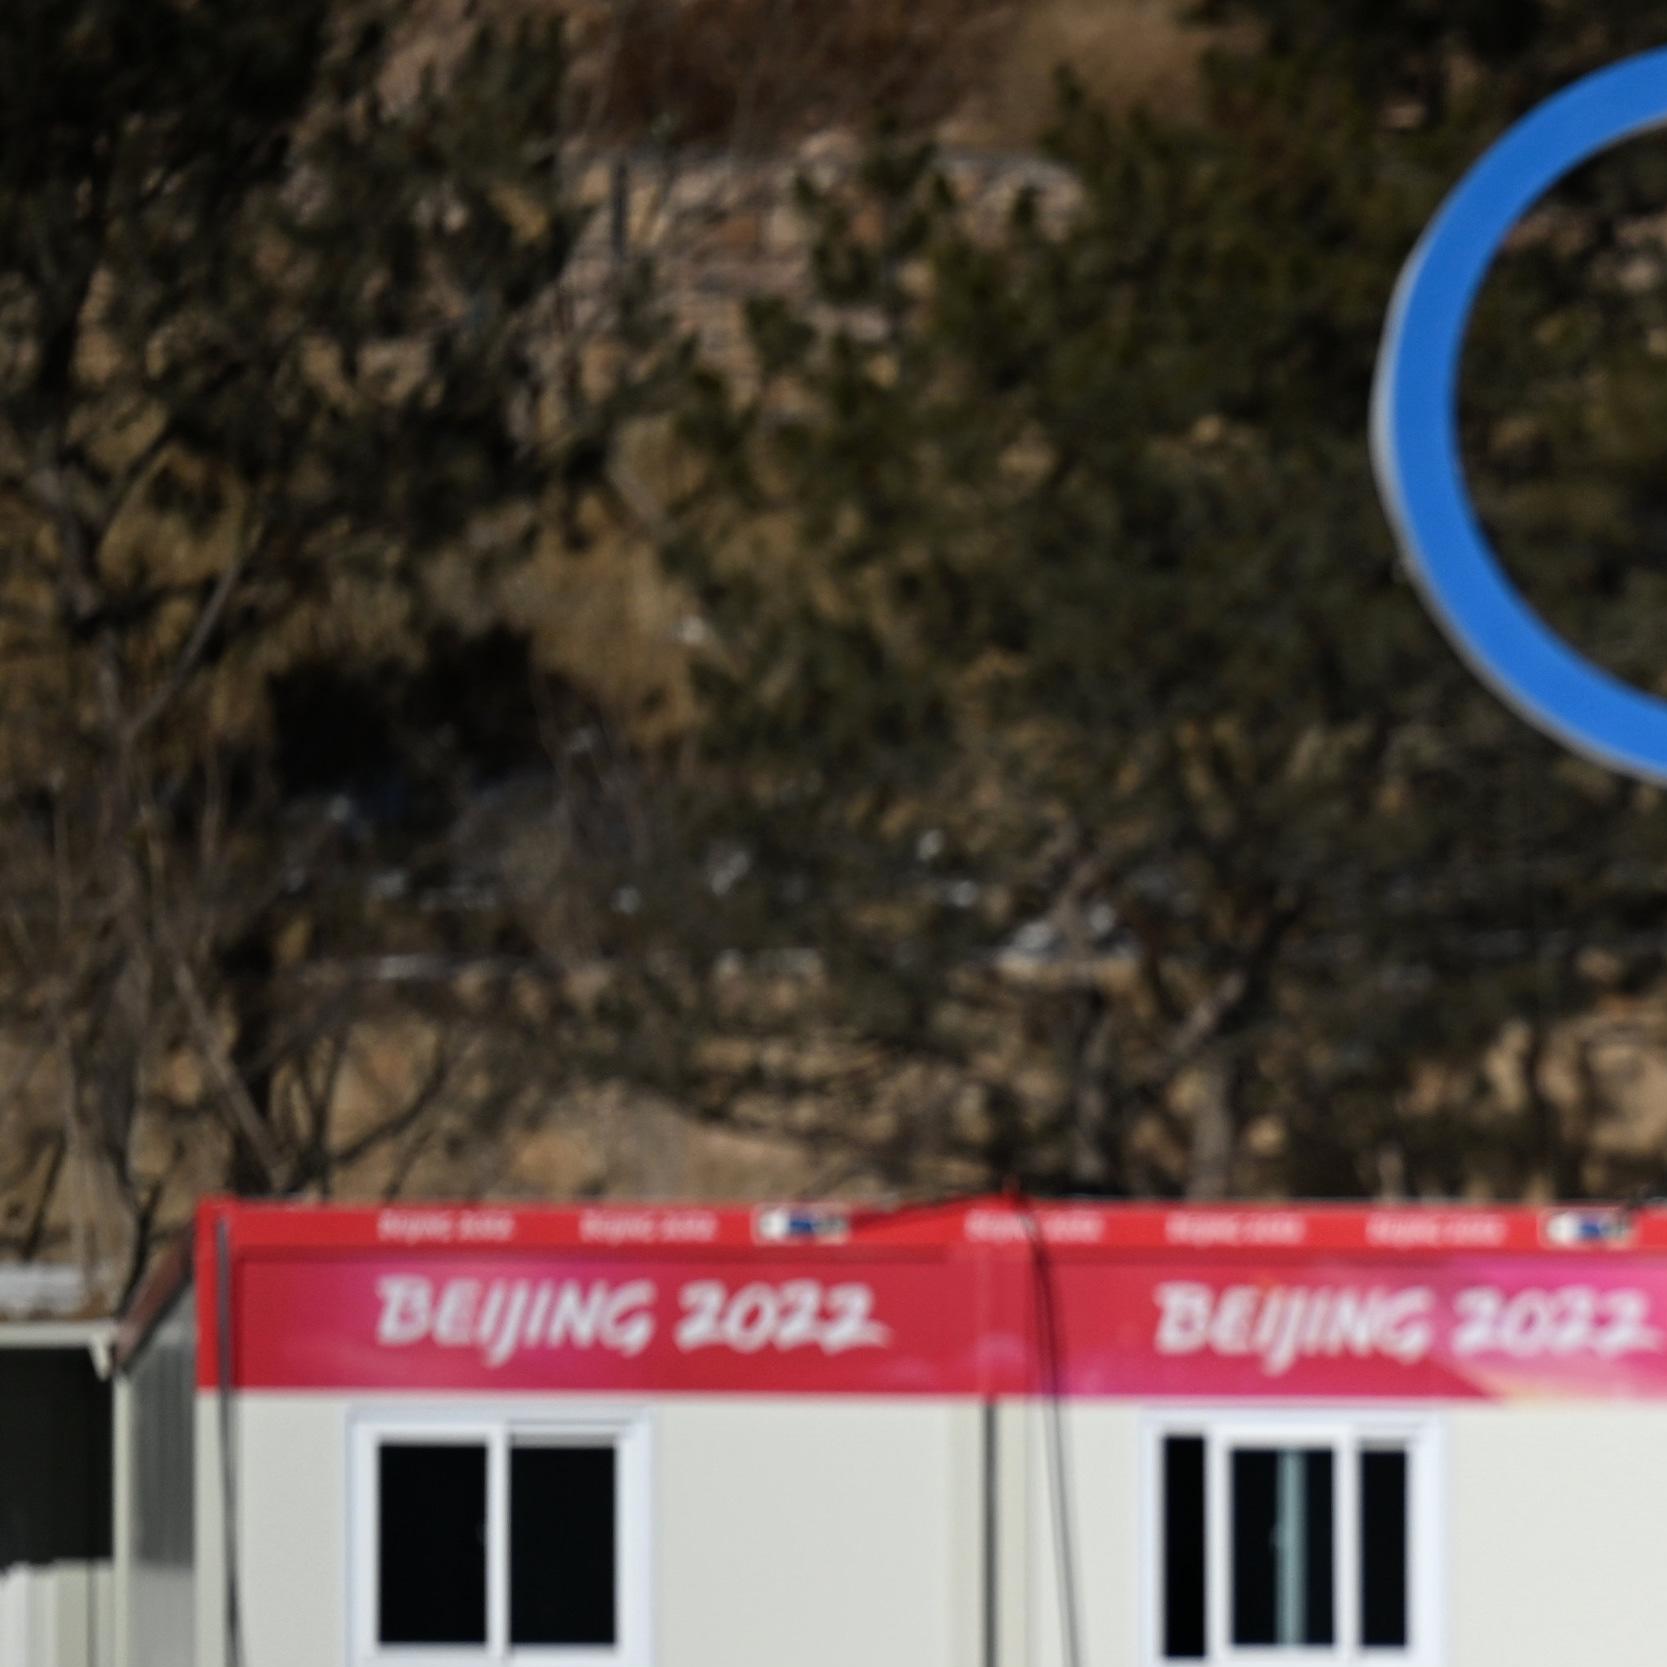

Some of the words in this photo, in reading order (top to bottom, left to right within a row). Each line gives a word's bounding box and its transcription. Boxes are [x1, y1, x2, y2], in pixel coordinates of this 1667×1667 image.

[378, 1277, 654, 1366] BEIJING
[673, 1279, 889, 1353] 2022
[1153, 1280, 1433, 1376] BEIJING
[1452, 1285, 1664, 1354] 2022
